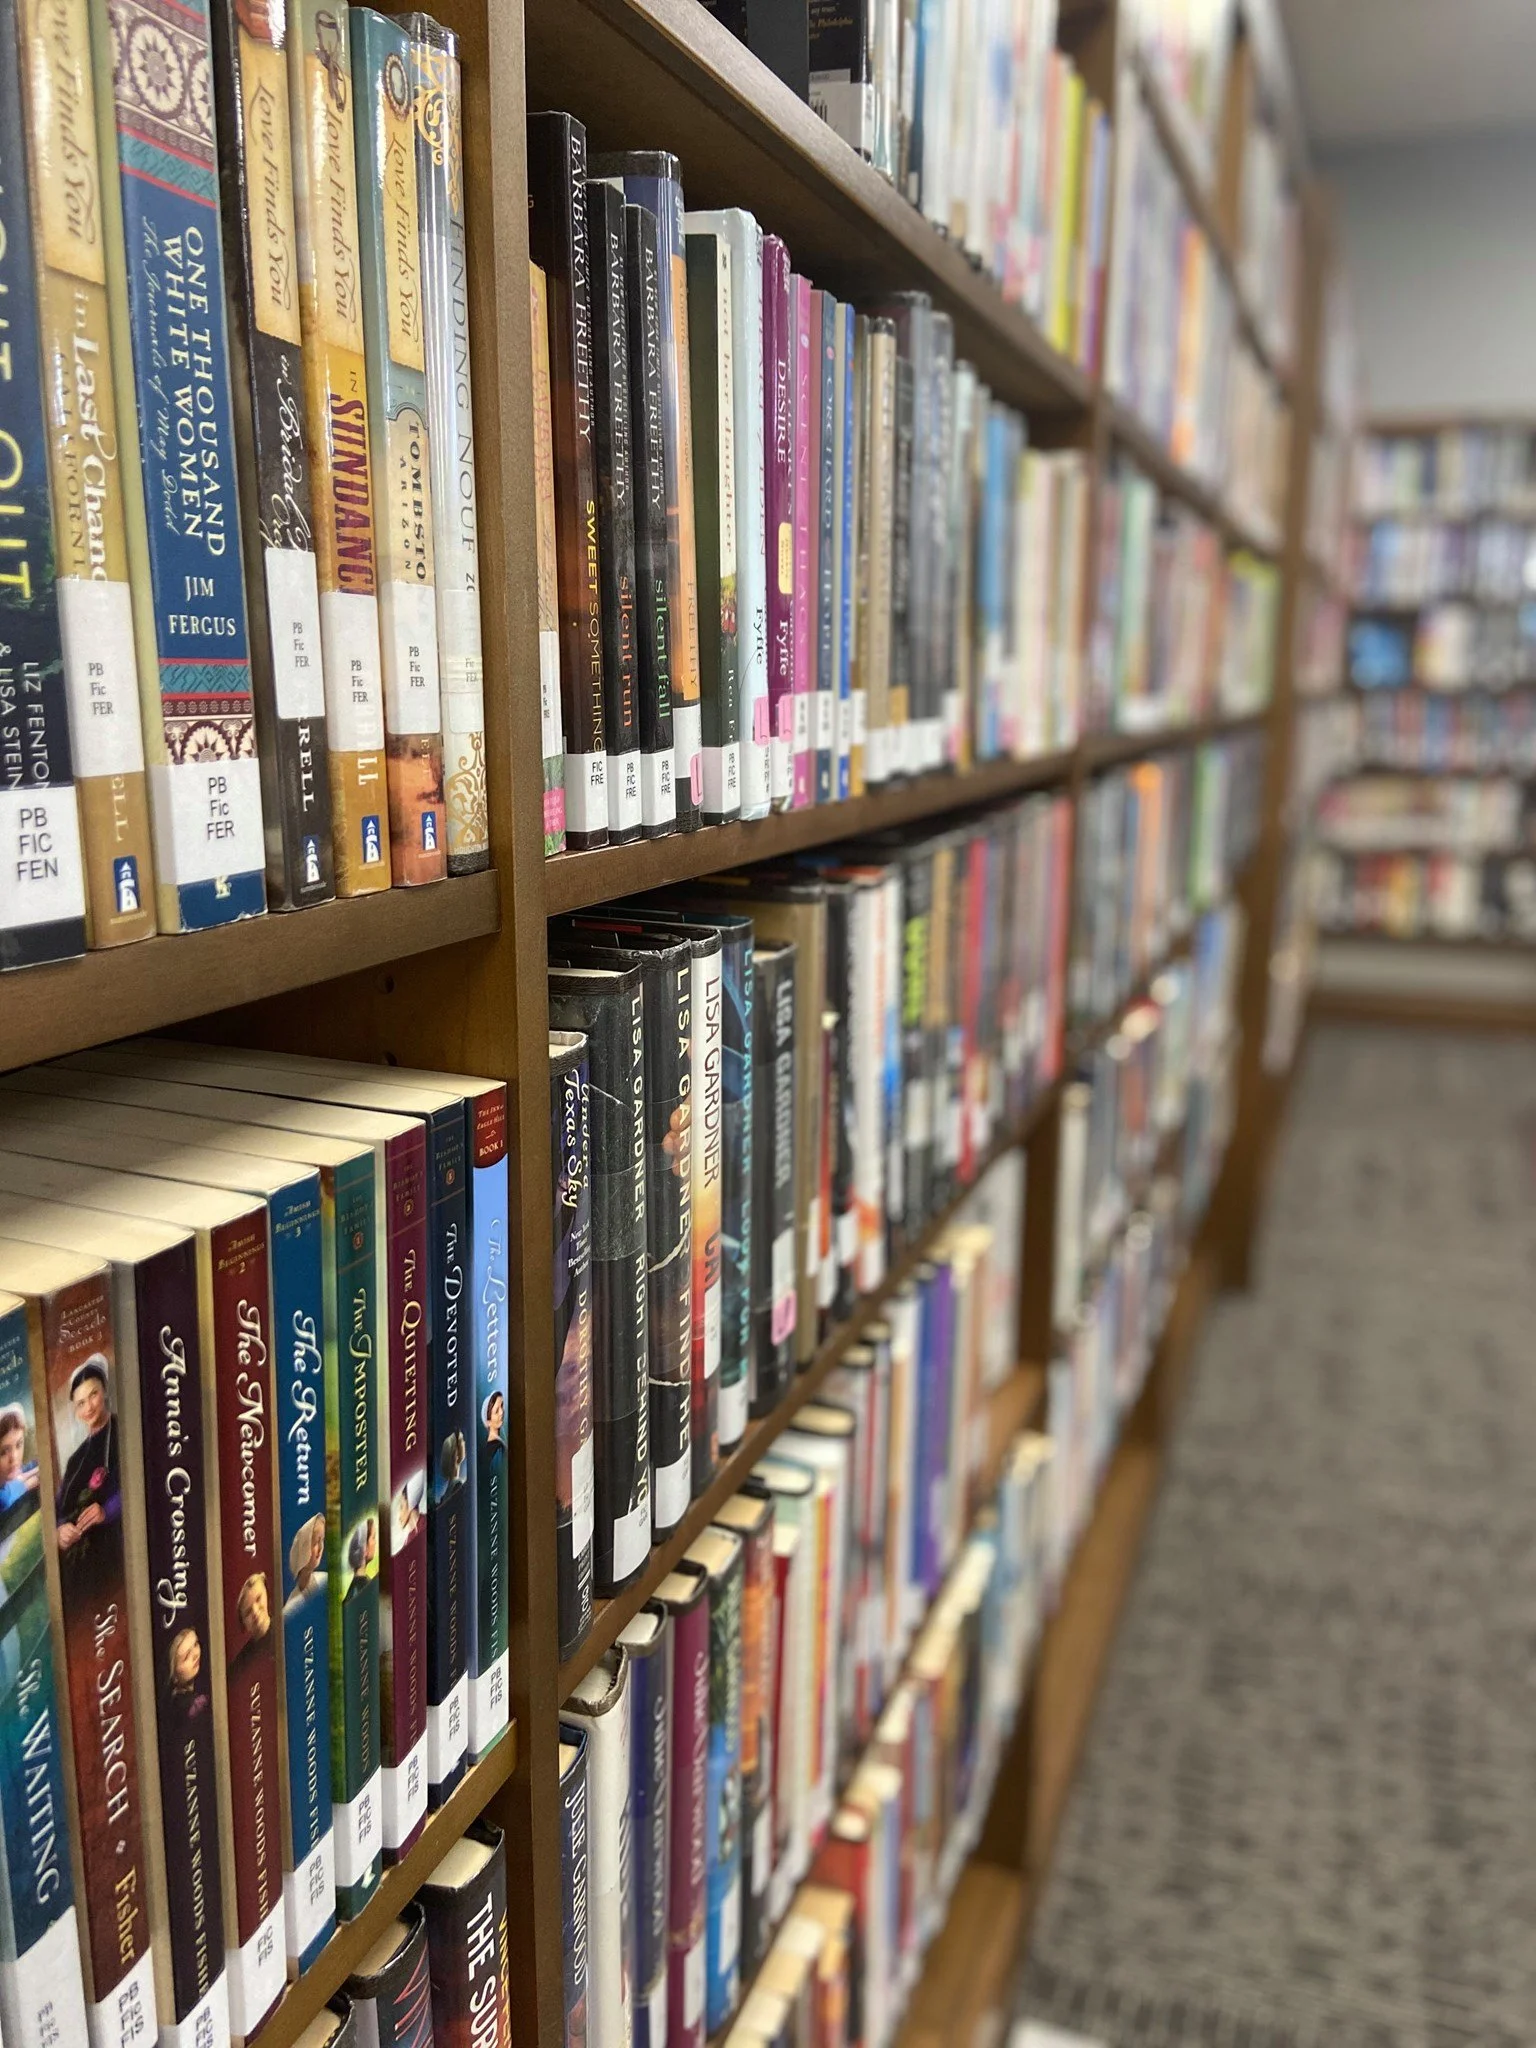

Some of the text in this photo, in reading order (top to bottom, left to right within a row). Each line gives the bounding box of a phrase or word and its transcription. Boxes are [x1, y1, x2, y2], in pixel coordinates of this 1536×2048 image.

[250, 76, 291, 312] Love Finds You
[326, 102, 357, 325] Love Finds You
[395, 202, 420, 343] Finds You
[570, 135, 592, 445] BARBARA FREETHY
[450, 218, 470, 411] FINDING
[350, 371, 358, 393] IN
[610, 231, 626, 507] BARBARA FREETHY
[645, 247, 662, 510] BARBARA FREETHY
[73, 332, 117, 461] Last
[142, 258, 181, 537] Journals of May Dodd
[163, 235, 204, 538] WHITE WOMEN
[186, 226, 226, 556] ONE THOUSAND
[777, 359, 787, 463] DESIRE
[276, 378, 311, 539] Bridal
[824, 376, 834, 529] ORCHARD
[458, 434, 475, 552] NOUF
[722, 417, 735, 553] daughter
[185, 576, 215, 601] JIM
[168, 614, 237, 637] FERGUS
[292, 621, 304, 635] PB
[586, 499, 603, 754] SWEET SOMETHING
[753, 606, 765, 665] Fyffe
[293, 638, 305, 652] Fic
[408, 646, 421, 658] PB
[620, 576, 633, 727] silent run
[655, 579, 672, 718] silent fall
[776, 619, 789, 676] Fyffe
[22, 662, 42, 693] LIZ
[88, 663, 105, 676] PB
[295, 656, 310, 669] FER
[351, 659, 363, 672] PB
[409, 661, 421, 673] Fic
[90, 683, 107, 696] Fic
[351, 676, 364, 688] Fic
[352, 691, 369, 703] FER
[410, 676, 426, 688] FER
[92, 702, 114, 715] FER
[590, 774, 604, 785] FRE
[591, 761, 604, 772] FIC
[626, 762, 635, 773] PB
[626, 775, 636, 786] FIC
[661, 760, 670, 771] PB
[661, 772, 671, 784] FIC
[208, 777, 228, 795] PB
[625, 786, 637, 798] FRE
[660, 783, 672, 795] FRE
[728, 777, 737, 789] FRE
[20, 807, 48, 829] PB
[209, 800, 230, 818] Fic
[18, 833, 53, 855] FIC
[206, 820, 236, 841] FER
[17, 858, 59, 882] FEN
[742, 947, 753, 1176] LISA GARDNER
[704, 976, 720, 1190] LISA GARDNER
[774, 979, 793, 1189] LISA GARDNER
[563, 1068, 581, 1148] Texas
[631, 996, 646, 1223] LISA GARDNER
[677, 967, 691, 1261] LISA GARDNER
[479, 1141, 499, 1157] BOOK
[581, 1083, 591, 1190] Under a
[561, 1154, 583, 1209] Sky
[274, 1208, 321, 1234] BEGINNINGS
[294, 1226, 302, 1239] 3
[218, 1242, 266, 1271] BEGINNINGS
[238, 1261, 247, 1274] 2
[444, 1265, 463, 1408] DEVOTED
[482, 1265, 507, 1383] Letters
[679, 1289, 691, 1384] FIND
[68, 1334, 94, 1353] BOOK
[577, 1289, 589, 1414] DOROTHY
[401, 1298, 422, 1453] QUIETING
[287, 1309, 322, 1506] The Return
[351, 1333, 372, 1493] IMPOSTER
[236, 1299, 268, 1558] The Newcomer
[157, 1325, 191, 1630] Anna's Crossing
[489, 1475, 499, 1626] SUZANNE WOODS
[407, 1559, 418, 1647] SUZANNE
[94, 1603, 119, 1659] The
[16, 1657, 42, 1718] The
[358, 1609, 370, 1771] SUZANNE WOODS
[408, 1652, 418, 1717] WOODS
[490, 1666, 502, 1685] PB
[490, 1678, 503, 1697] FIC
[303, 1625, 319, 1805] SUZANNE WOODS
[449, 1695, 459, 1714] PB
[490, 1692, 503, 1709] FIS
[449, 1707, 461, 1728] FIC
[449, 1721, 460, 1741] FIS
[248, 1681, 268, 1866] SUZANNE WOODS
[407, 1754, 419, 1774] PB
[407, 1766, 419, 1788] FIC
[22, 1708, 60, 1904] WAITING
[358, 1794, 370, 1816] PB
[407, 1780, 419, 1802] FIS
[97, 1659, 136, 1965] SEARCH Fisher
[358, 1807, 371, 1831] FIC
[183, 1739, 205, 1930] SUZANNE WOODS
[358, 1821, 372, 1844] FIS
[309, 1854, 323, 1877] PB
[309, 1867, 324, 1892] FIC
[310, 1881, 325, 1905] FIS
[565, 1781, 587, 1985] JULIE GARWOOD
[257, 1924, 273, 1951] FIC
[466, 1891, 495, 1982] THE
[257, 1940, 273, 1968] FIS
[498, 1906, 510, 2000] VINCE
[118, 1980, 139, 2013] PB
[120, 2001, 142, 2031] FIC
[195, 2006, 211, 2031] PB
[121, 2016, 144, 2048] FIS
